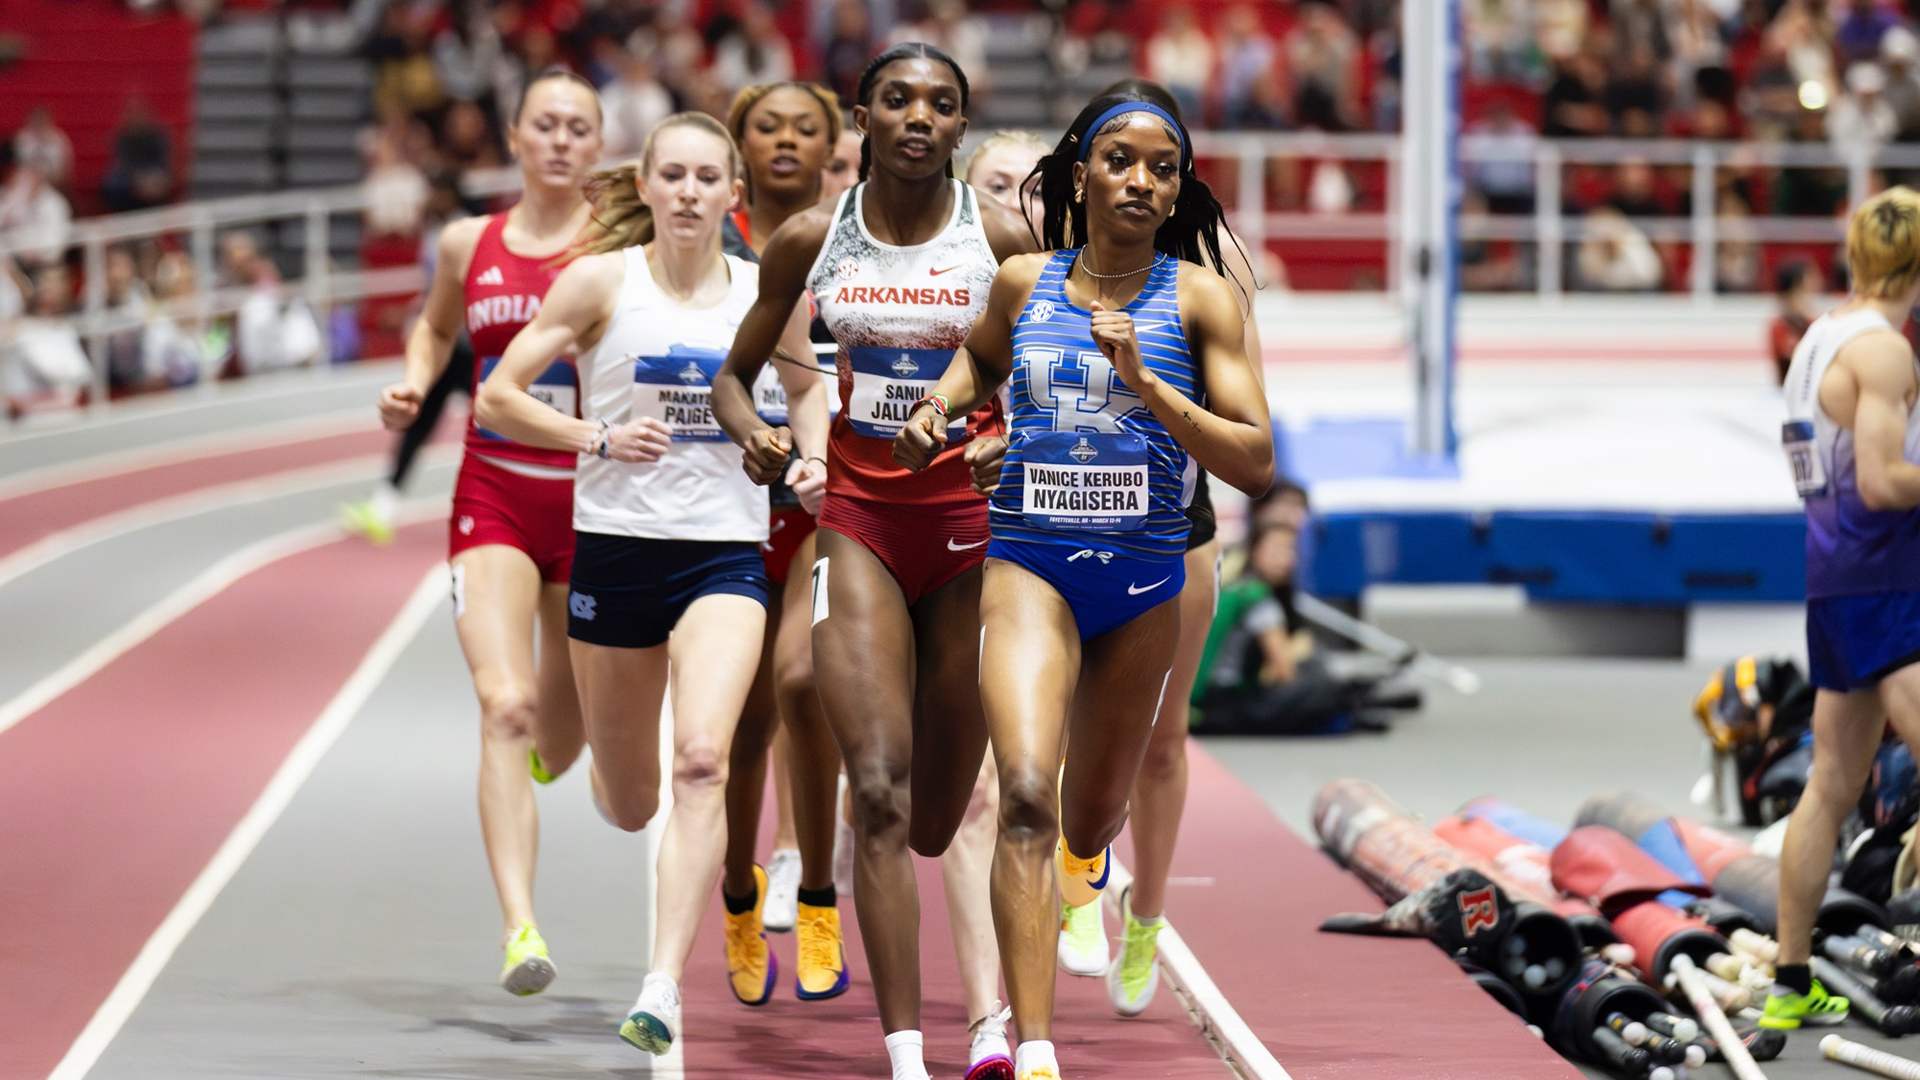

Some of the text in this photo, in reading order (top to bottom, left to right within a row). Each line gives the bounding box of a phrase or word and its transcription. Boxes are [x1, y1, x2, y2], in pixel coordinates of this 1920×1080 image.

[835, 287, 970, 306] ARKANSAS
[467, 294, 542, 334] INDIA
[1032, 302, 1053, 320] SEC
[886, 384, 925, 401] SANU
[665, 406, 712, 425] PAIGE
[871, 401, 911, 422] JALL
[1030, 468, 1143, 487] VANICE KERUBO
[1033, 489, 1139, 511] NYAGISERA
[1456, 884, 1499, 938] R
